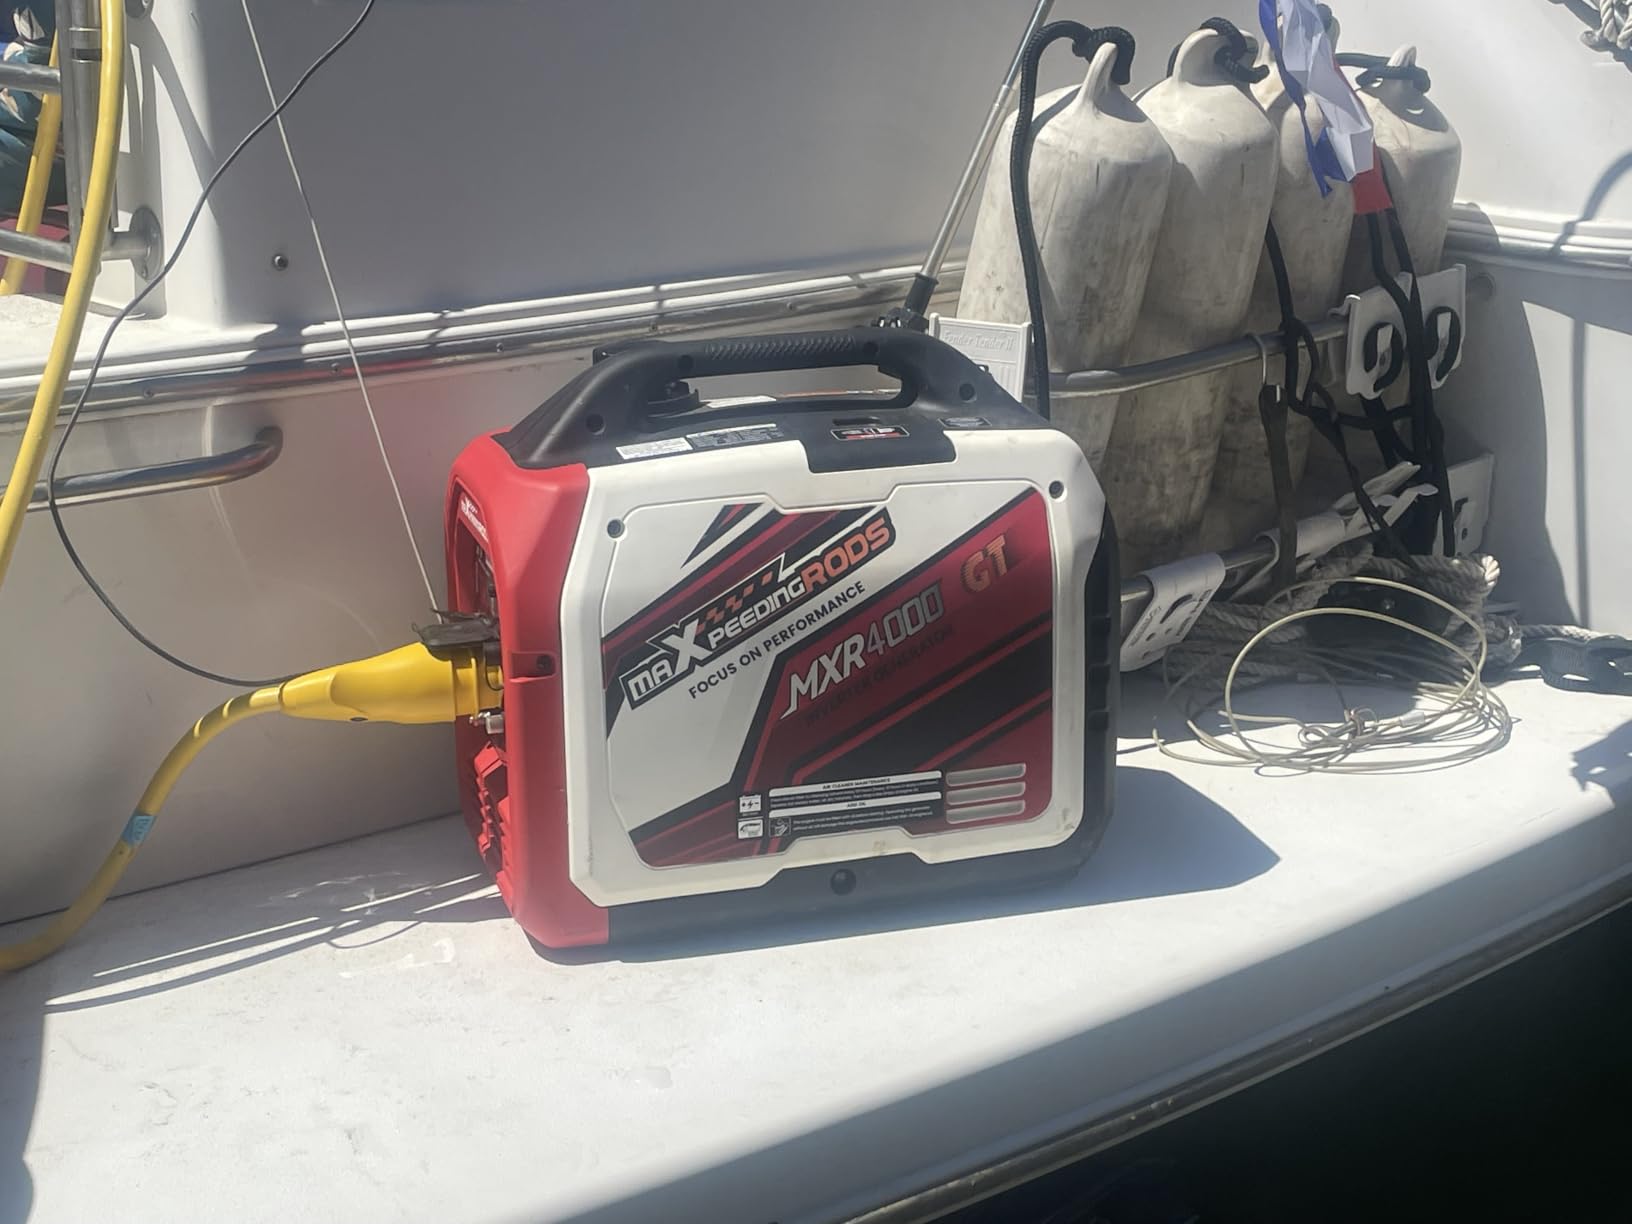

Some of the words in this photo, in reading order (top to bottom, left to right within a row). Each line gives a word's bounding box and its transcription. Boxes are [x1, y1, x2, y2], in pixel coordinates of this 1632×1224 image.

[689, 663, 737, 699] FOCUS
[740, 649, 762, 667] ON
[765, 581, 866, 652] PERFORMANCE
[779, 584, 945, 720] MXR4000
[960, 533, 1008, 593] GT
